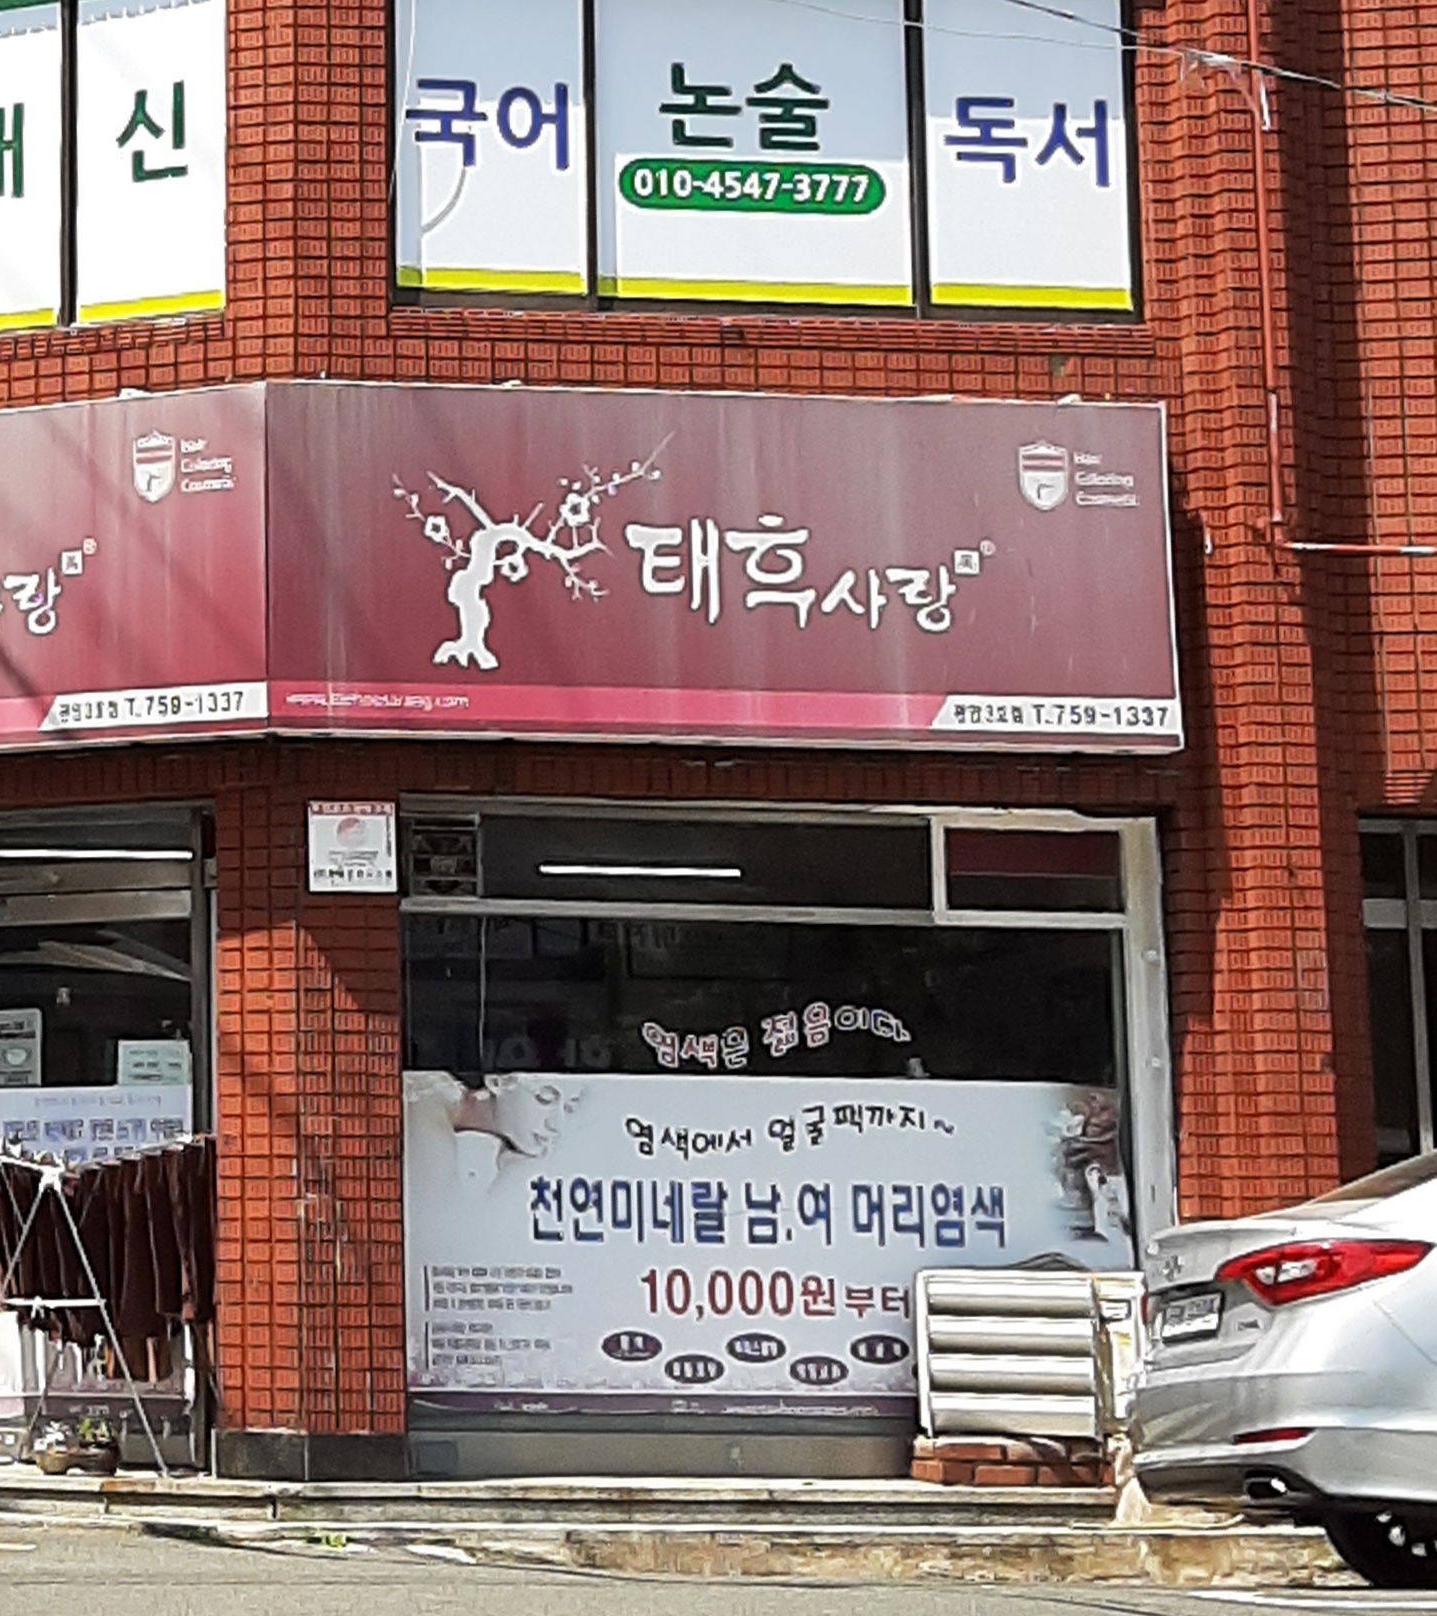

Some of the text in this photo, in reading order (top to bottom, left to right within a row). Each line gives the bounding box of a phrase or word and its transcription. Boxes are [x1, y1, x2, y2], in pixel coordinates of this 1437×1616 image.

[406, 78, 569, 171] 국어
[658, 61, 830, 152] 논술
[943, 95, 1112, 187] 독서
[632, 167, 870, 203] 010-4547-3777
[642, 1021, 750, 1070] 염색은
[625, 1117, 753, 1161] 염색에서
[530, 1176, 1007, 1249] 천연미네랄 남.여 머리염색
